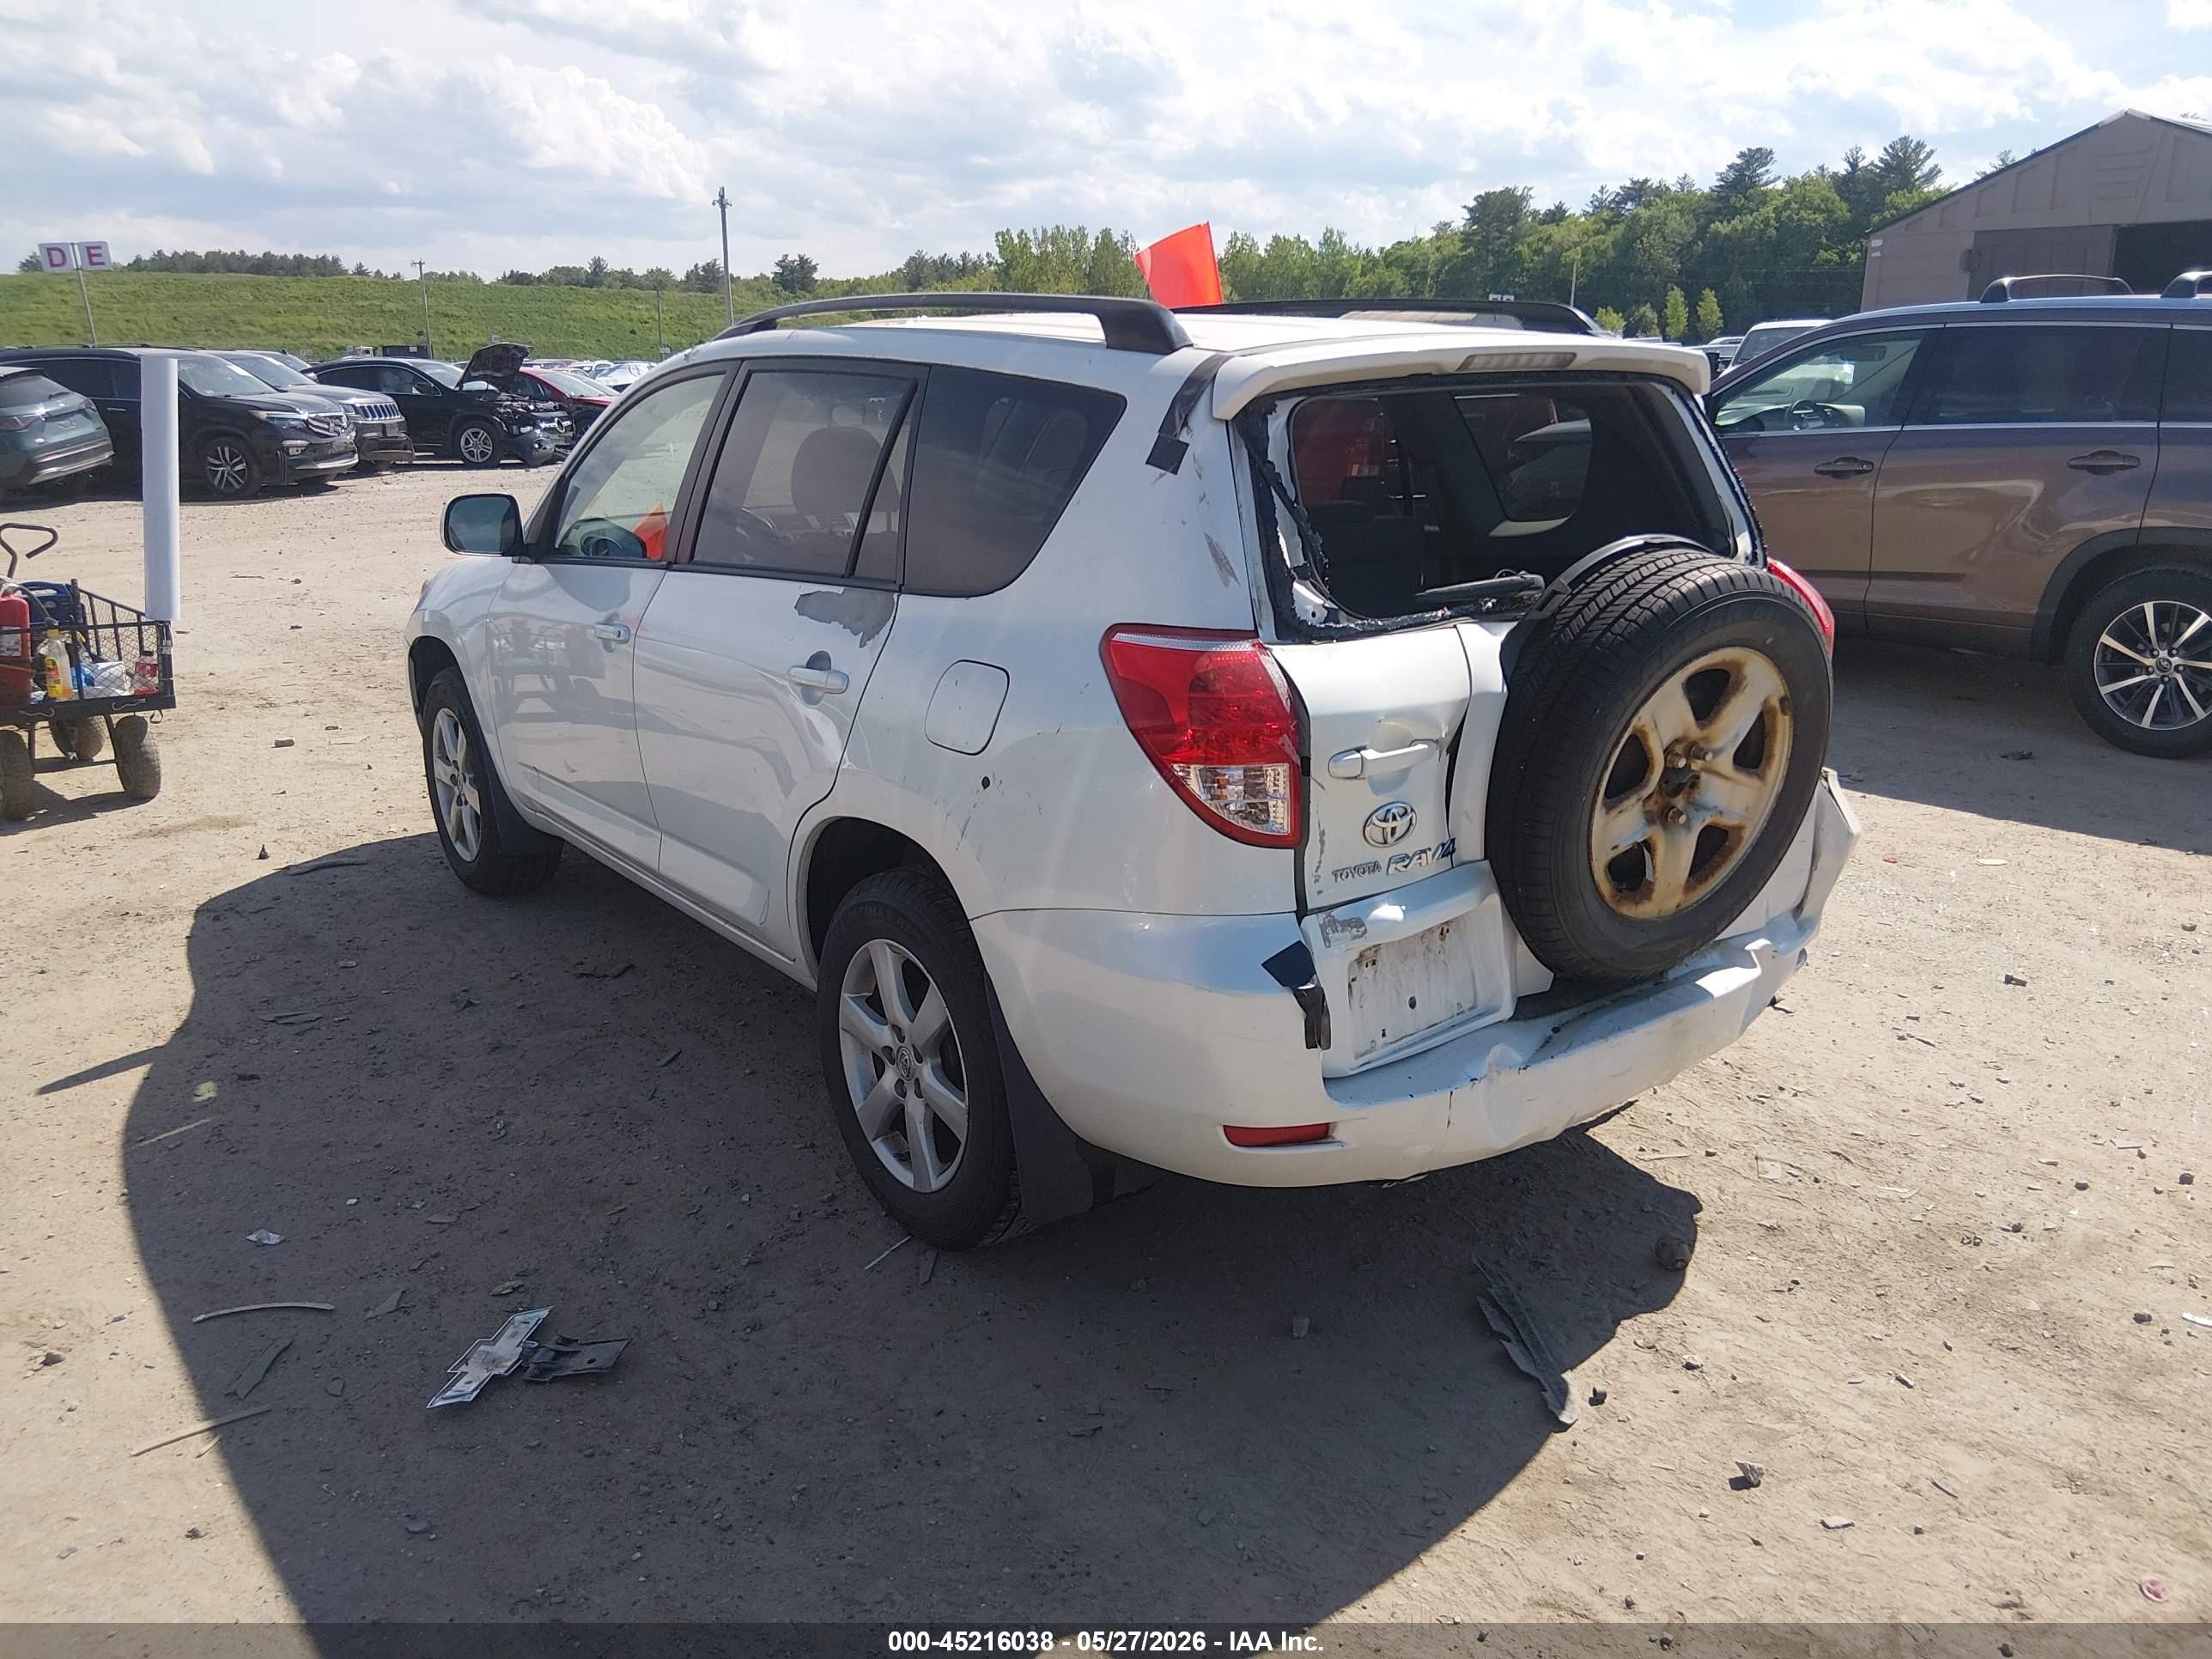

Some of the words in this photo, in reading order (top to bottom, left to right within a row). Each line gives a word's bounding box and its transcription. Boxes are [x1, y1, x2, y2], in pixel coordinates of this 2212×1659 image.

[46, 246, 68, 268] D
[86, 246, 106, 266] E
[1332, 860, 1382, 882] TOYOTA
[1386, 837, 1456, 876] RAV4
